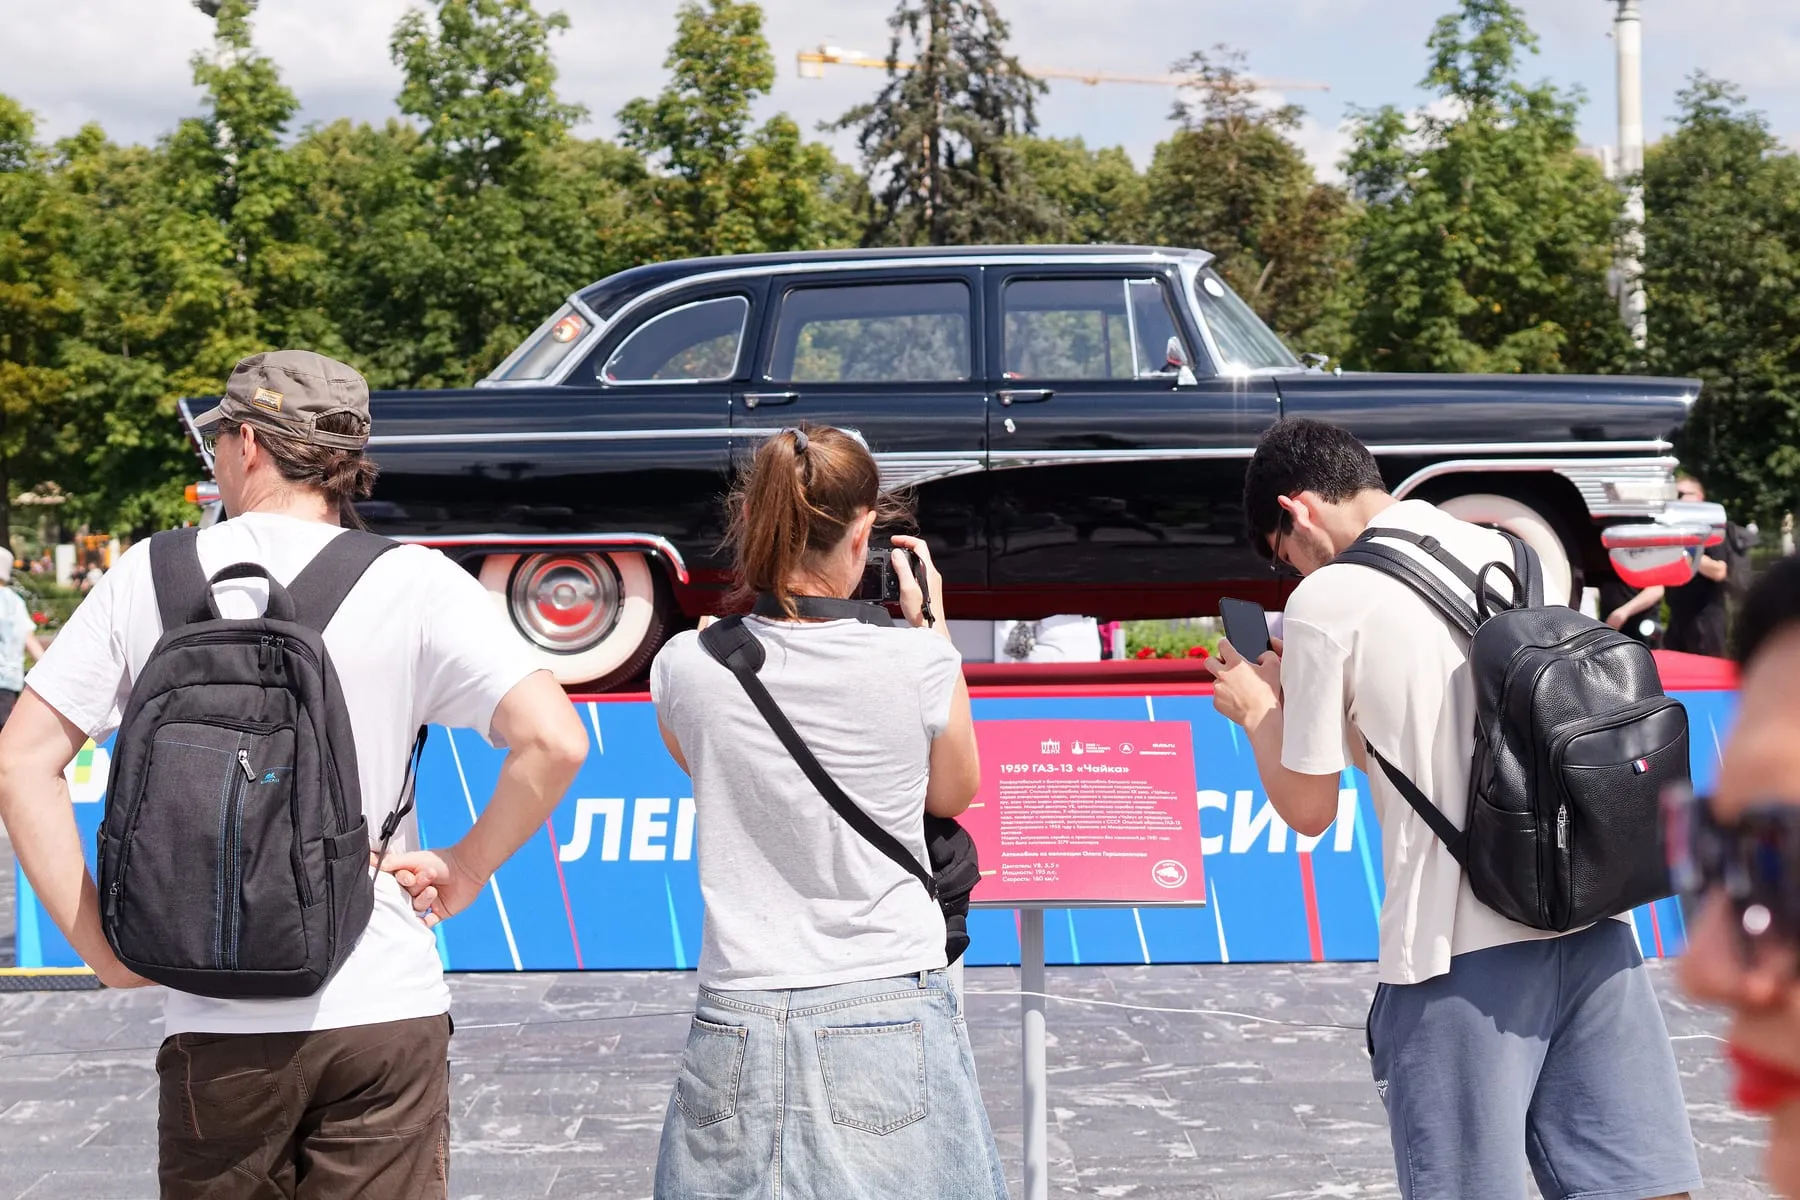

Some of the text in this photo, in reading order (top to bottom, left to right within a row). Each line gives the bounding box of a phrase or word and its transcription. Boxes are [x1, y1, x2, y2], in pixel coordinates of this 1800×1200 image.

[1000, 763, 1130, 773] 1959 ГАЗ-13 «Чайка»
